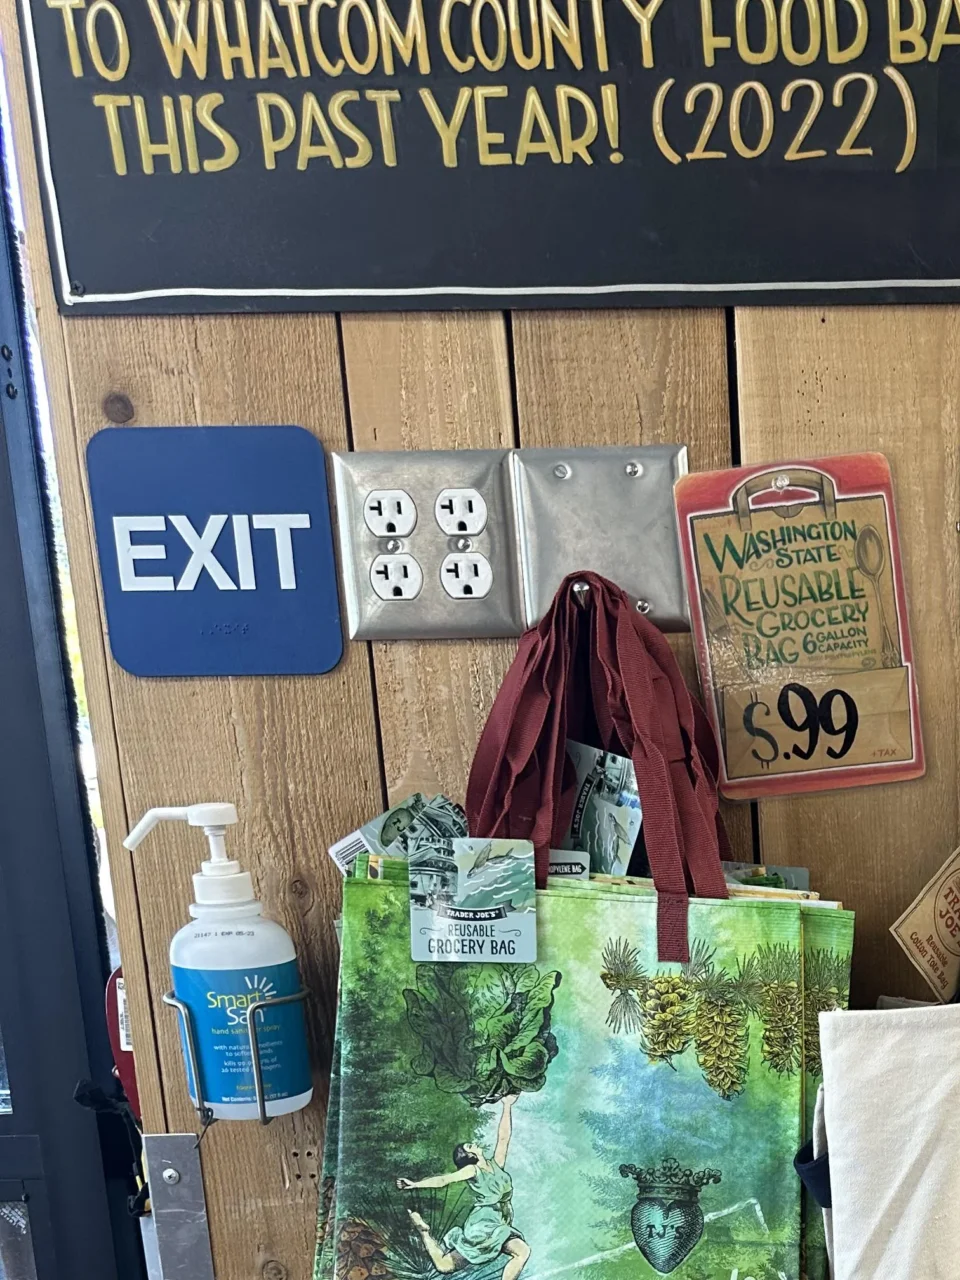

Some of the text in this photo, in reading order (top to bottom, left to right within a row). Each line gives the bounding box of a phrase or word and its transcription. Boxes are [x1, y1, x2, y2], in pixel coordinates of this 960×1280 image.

[46, 0, 131, 81] TO
[147, 0, 430, 80] WHATCOM
[438, 0, 662, 74] COUNTY
[700, 0, 869, 67] FOOD
[93, 66, 918, 176] THIS PAST YEAR! (2022)
[112, 513, 311, 592] EXIT
[703, 520, 858, 574] WASHINGTON
[775, 544, 841, 569] STATE
[718, 567, 867, 627] REUSABLE
[755, 601, 870, 639] GROCERY
[802, 626, 867, 654] 6 GALLON
[817, 638, 869, 653] CAPACITY
[743, 682, 859, 770] $.99
[446, 909, 475, 919] TRADER
[447, 923, 496, 938] REUSABLE
[428, 938, 516, 955] GROCERY BAG
[925, 934, 949, 968] Reusable
[206, 990, 262, 1009] Smart
[226, 1006, 265, 1026] San
[211, 1027, 229, 1035] hand
